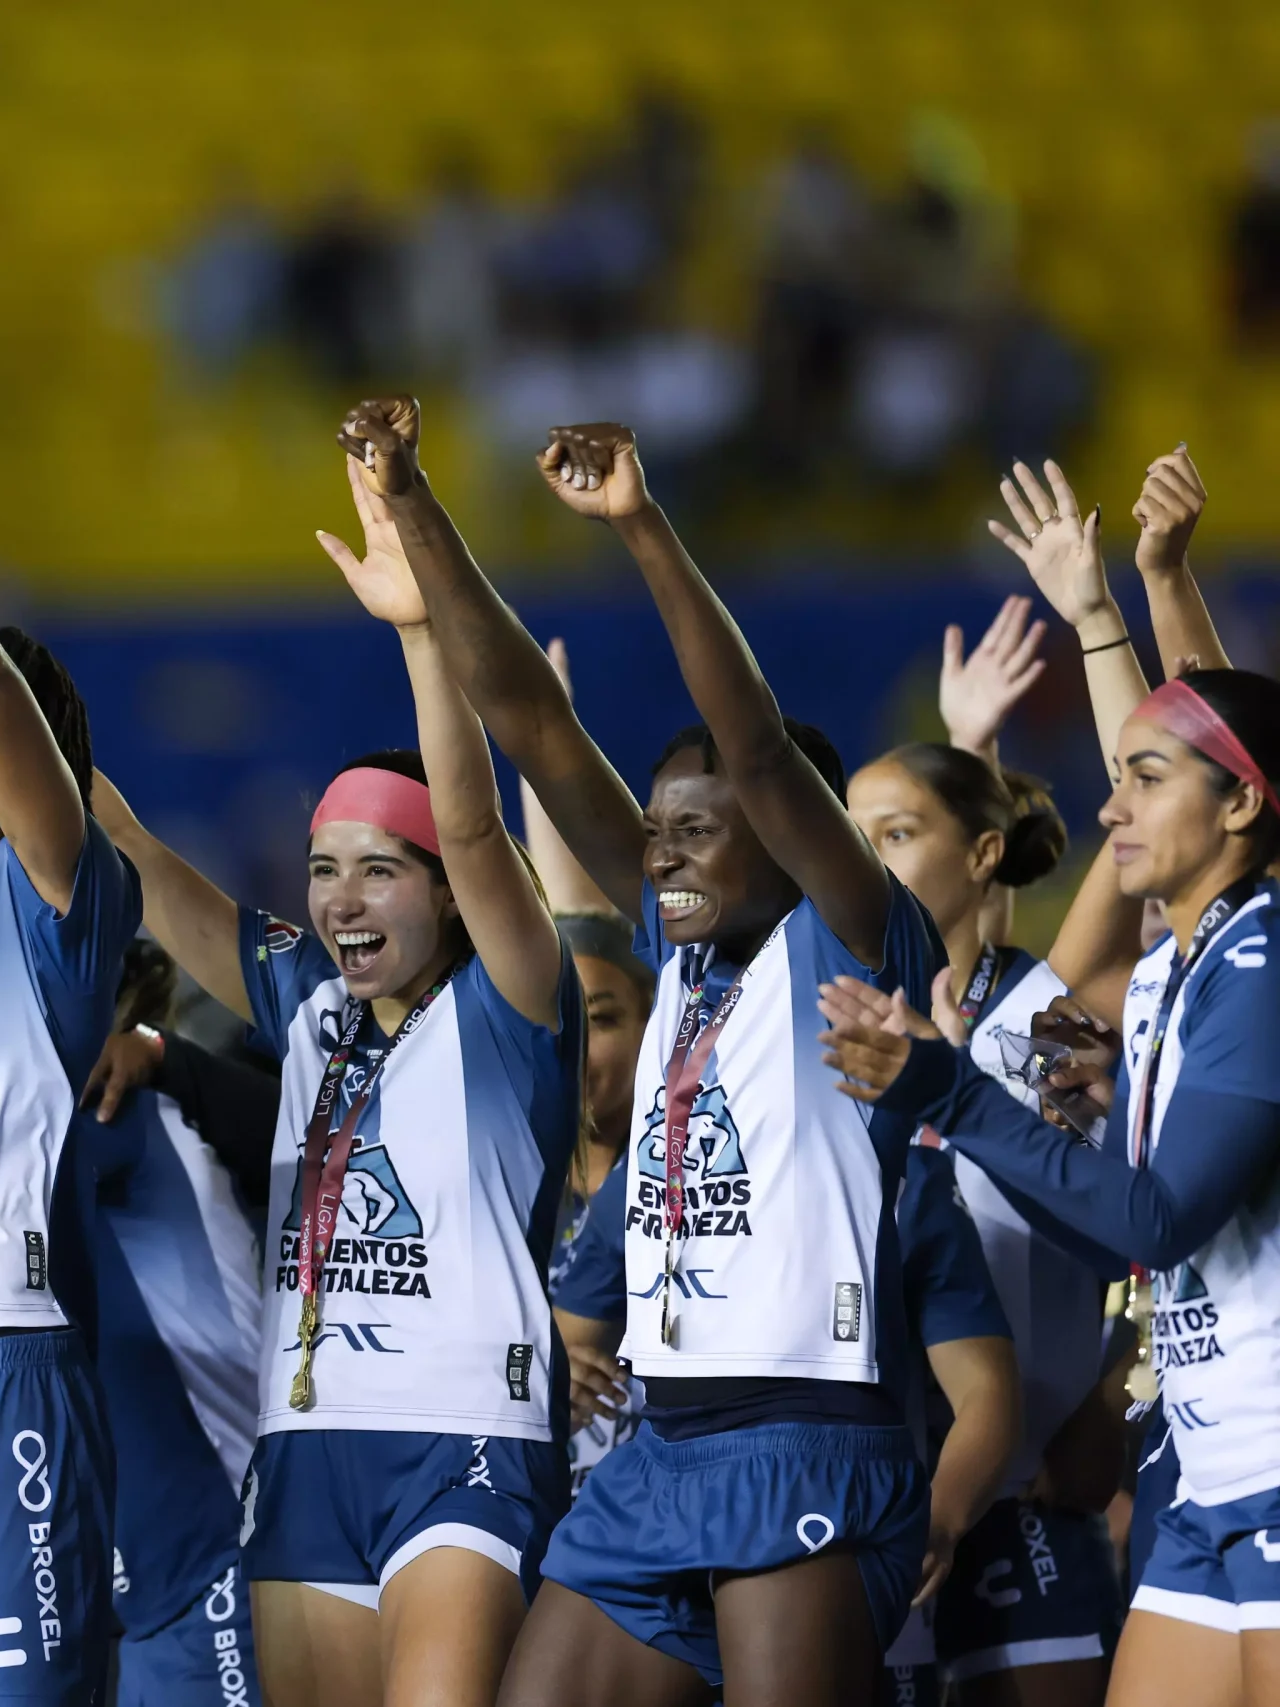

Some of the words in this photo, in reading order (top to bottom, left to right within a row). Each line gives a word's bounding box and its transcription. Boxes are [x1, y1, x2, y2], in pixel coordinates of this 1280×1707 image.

[1193, 897, 1231, 938] LIGA
[676, 1007, 697, 1049] LIGA
[317, 1077, 339, 1116] LIGA
[670, 1125, 684, 1169] LIGA
[315, 1193, 336, 1236] LIGA
[28, 1521, 62, 1662] BROXEL
